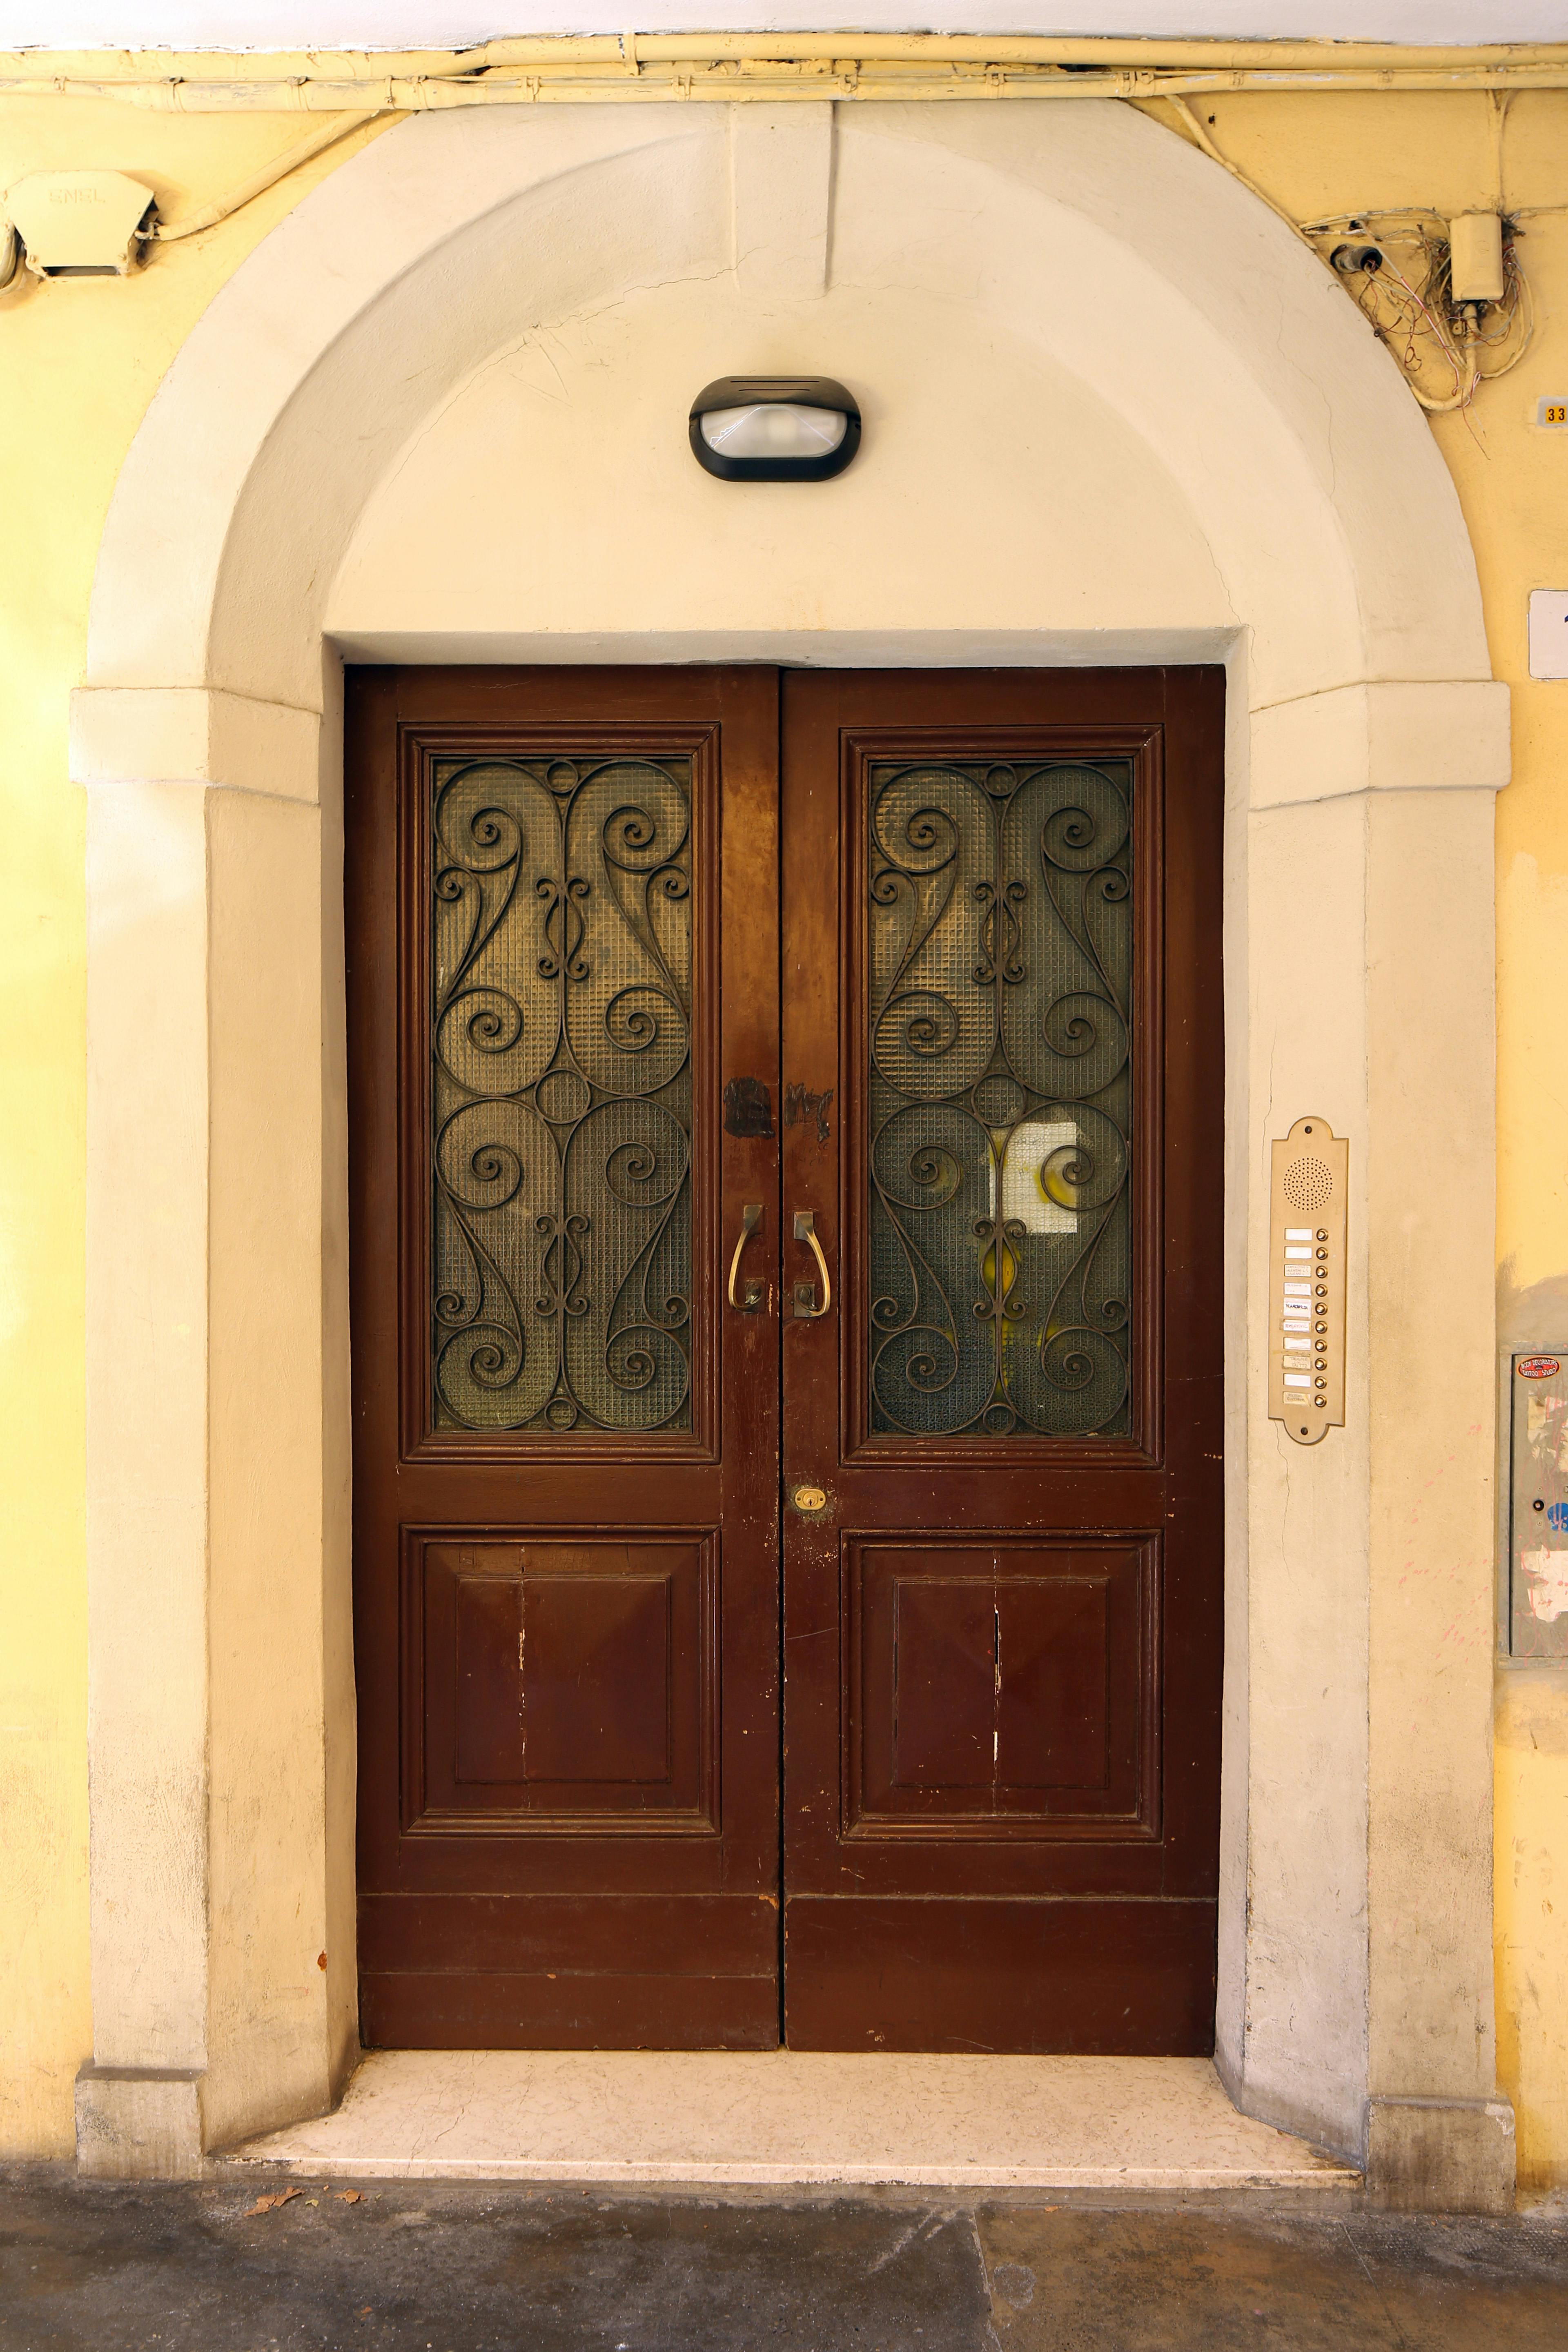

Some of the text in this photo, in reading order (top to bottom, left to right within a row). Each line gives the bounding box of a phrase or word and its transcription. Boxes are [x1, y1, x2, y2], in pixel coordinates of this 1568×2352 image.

[49, 189, 105, 204] ENEL
[1548, 408, 1565, 421] 33
[1520, 1361, 1531, 1369] BODY
[1541, 1367, 1556, 1376] STUDIO
